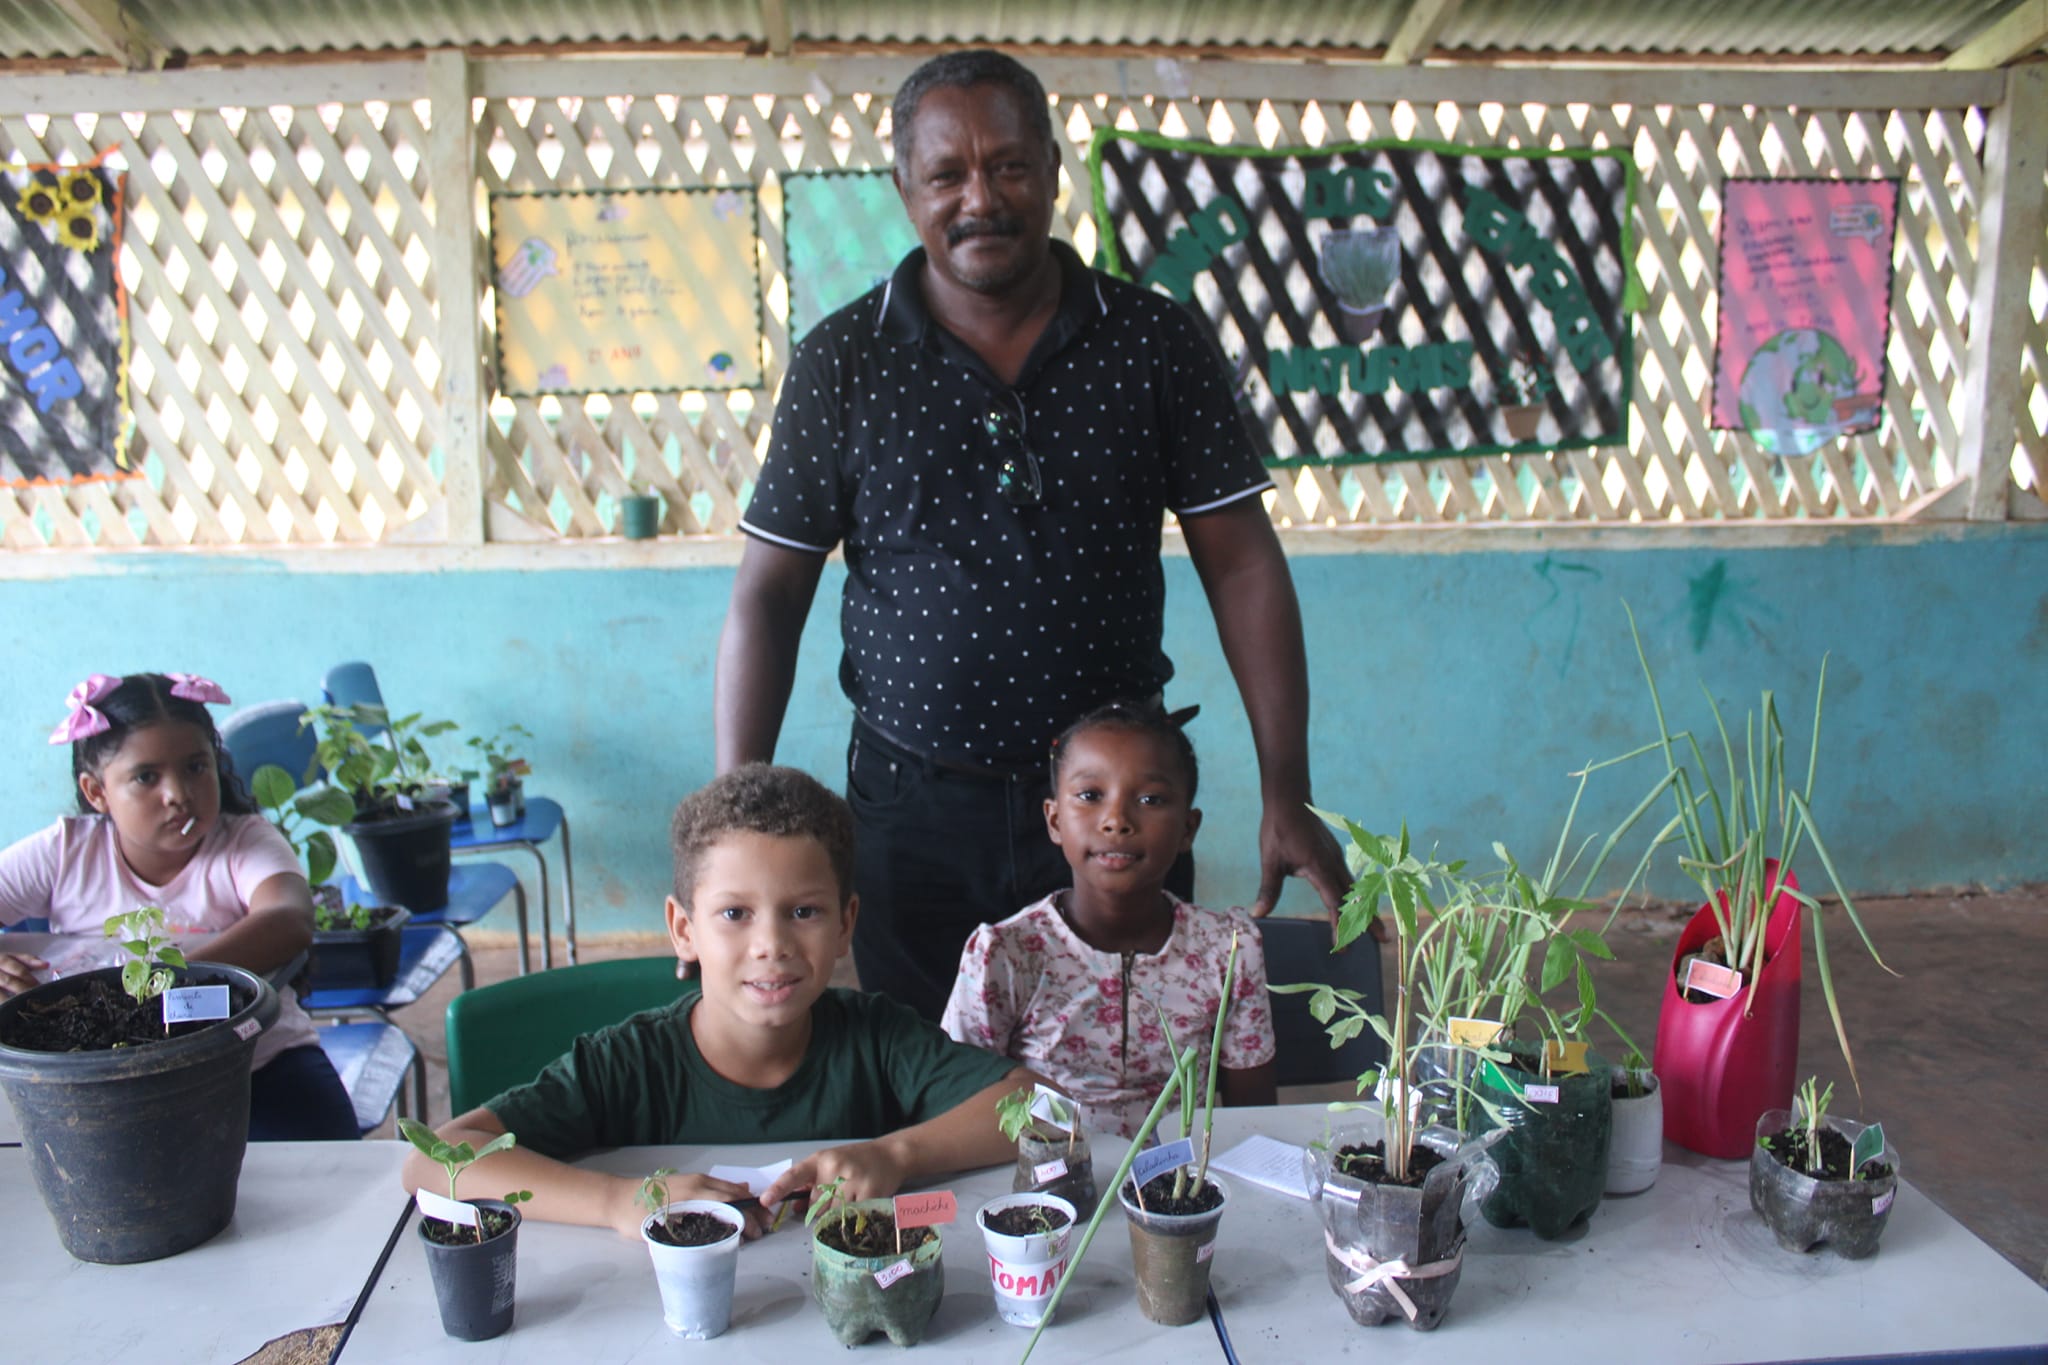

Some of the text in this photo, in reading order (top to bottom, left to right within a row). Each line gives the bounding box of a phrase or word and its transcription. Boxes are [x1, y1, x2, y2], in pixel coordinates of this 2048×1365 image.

[1304, 166, 1393, 219] DOS
[0, 266, 82, 413] MOR
[1269, 341, 1473, 397] NATURAIS
